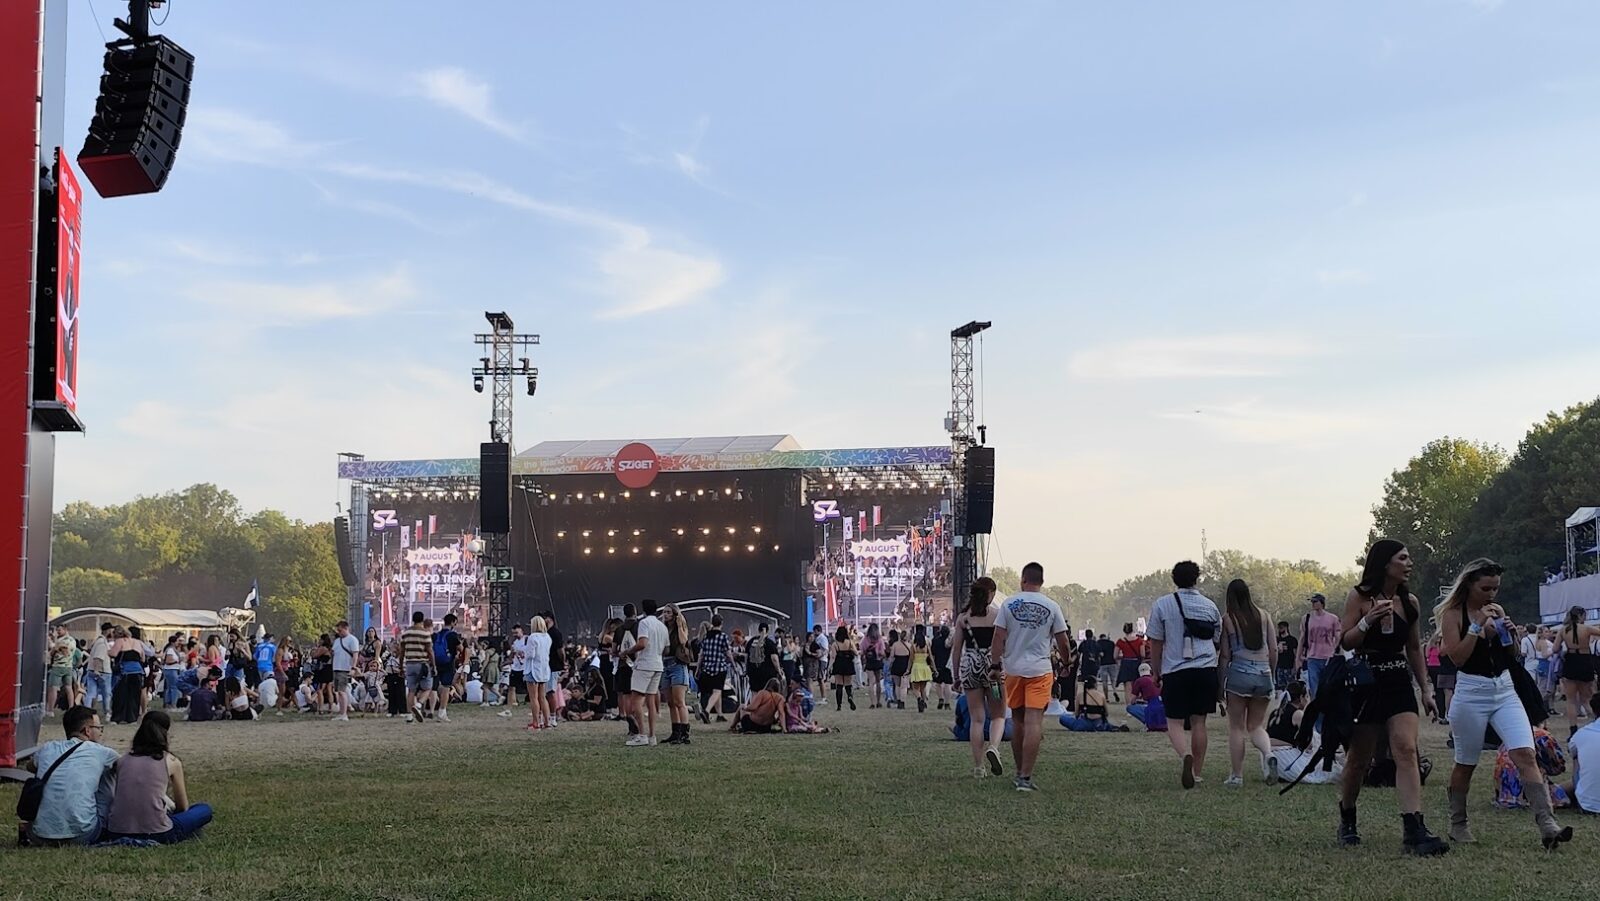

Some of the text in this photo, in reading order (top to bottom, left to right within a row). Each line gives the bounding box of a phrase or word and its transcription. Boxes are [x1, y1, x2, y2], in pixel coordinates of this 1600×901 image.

[618, 460, 654, 471] SZIGET
[813, 500, 840, 521] SZ
[373, 509, 398, 530] SZ
[865, 545, 900, 553] AUGUST
[420, 553, 453, 561] AUGUST
[836, 567, 925, 577] ALL GOOD THINGS
[393, 574, 476, 583] ALL GOOD THINGS
[857, 577, 906, 586] ARE HERE
[431, 584, 458, 592] HERE
